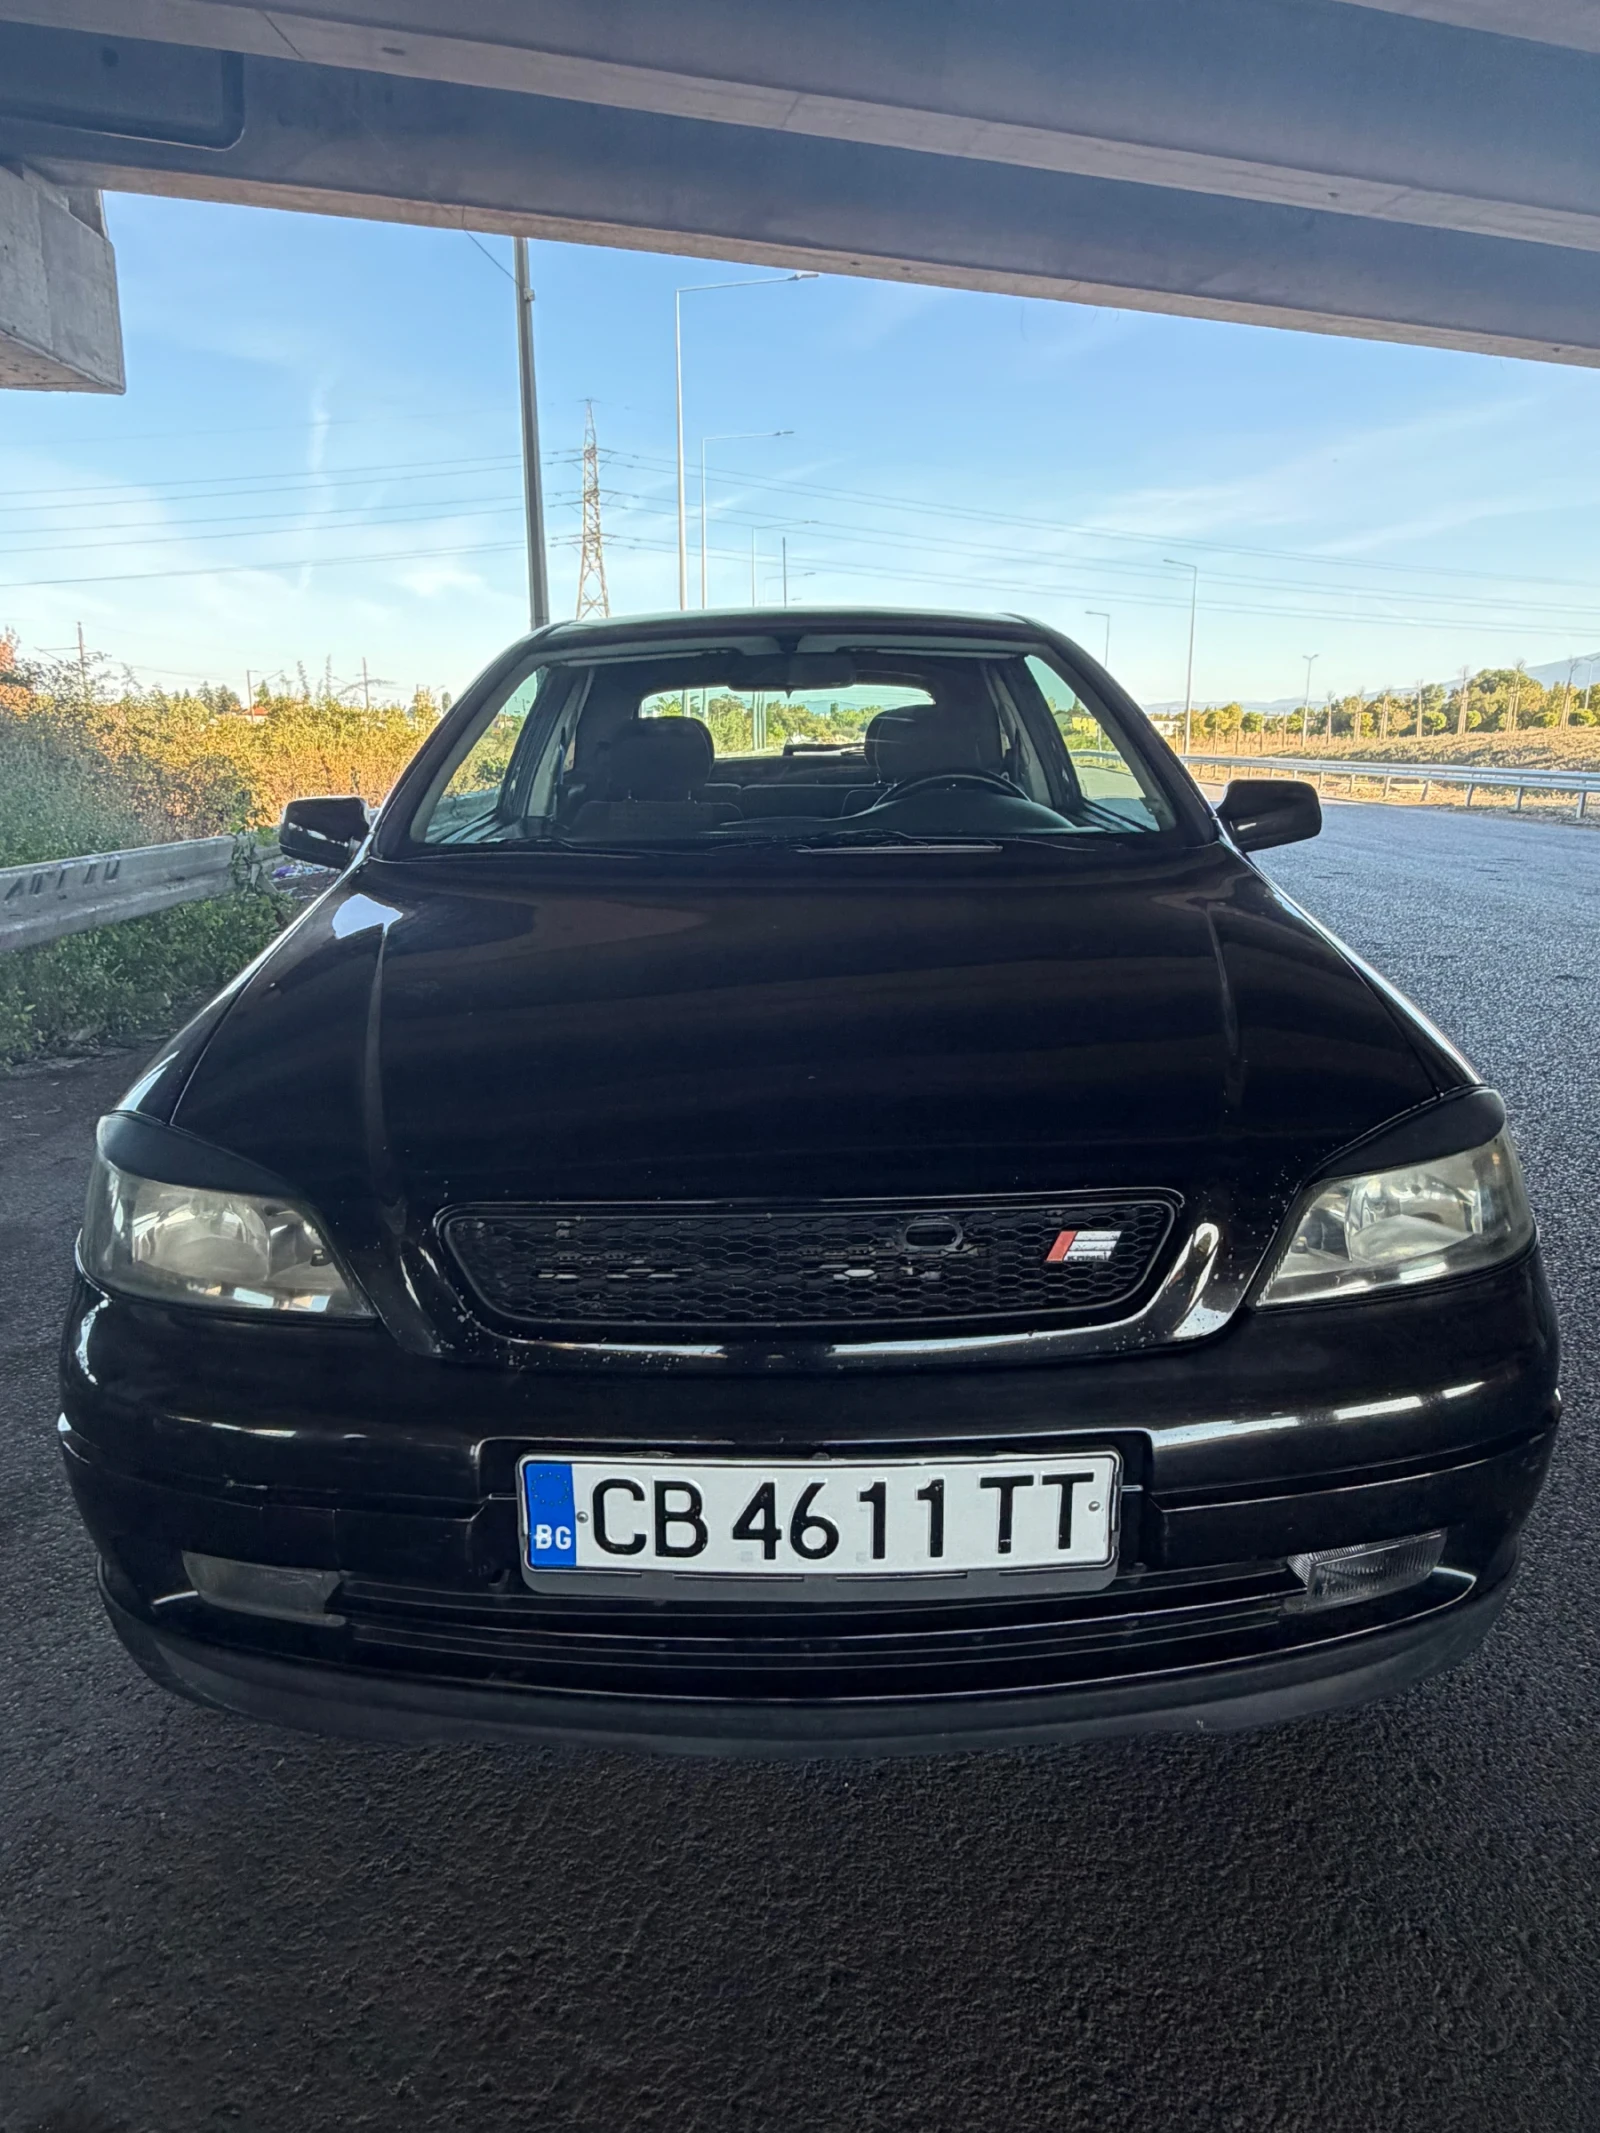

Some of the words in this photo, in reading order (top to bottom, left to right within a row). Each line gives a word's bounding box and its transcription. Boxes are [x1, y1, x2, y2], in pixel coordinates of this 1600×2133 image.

[535, 1524, 571, 1550] BG
[592, 1479, 709, 1558] CB
[731, 1477, 944, 1560] 4611
[980, 1472, 1094, 1554] TT
